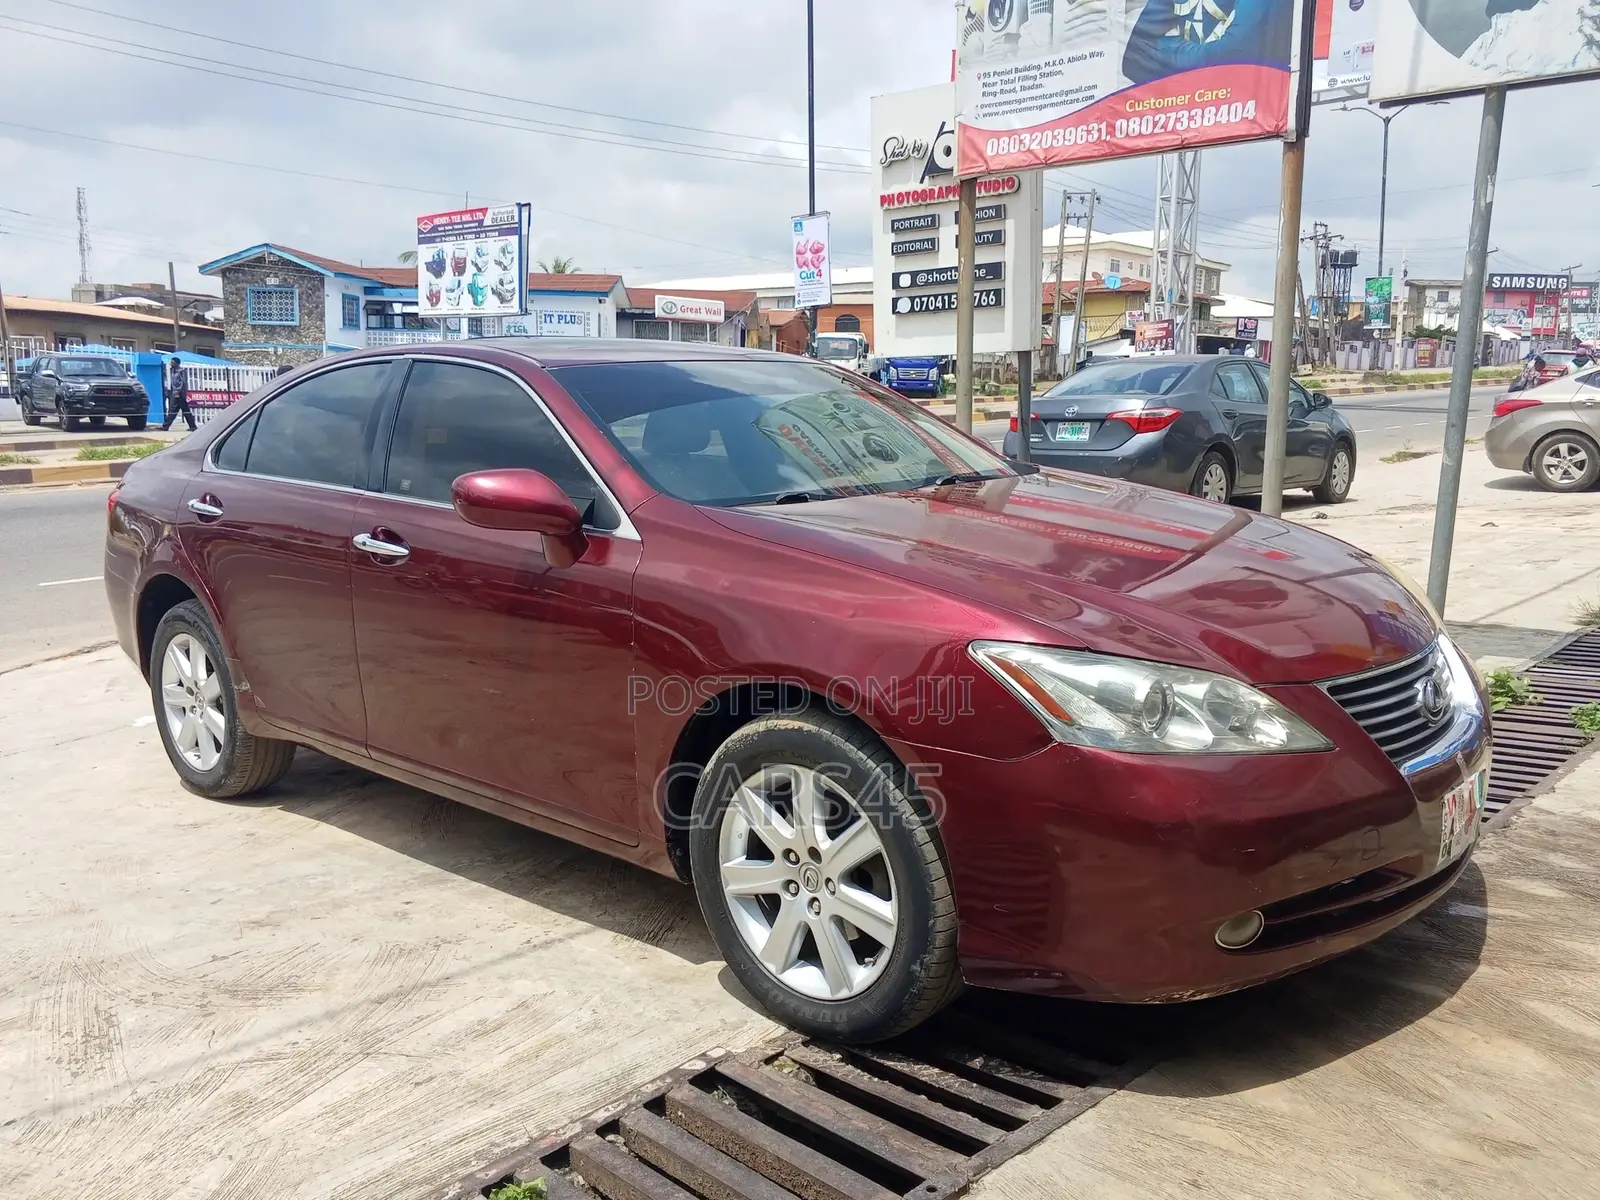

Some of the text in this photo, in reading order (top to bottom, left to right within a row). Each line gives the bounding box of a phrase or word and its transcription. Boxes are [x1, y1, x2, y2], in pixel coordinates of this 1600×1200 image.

[993, 68, 1013, 77] Peniel
[1014, 64, 1043, 73] Building,
[1044, 59, 1066, 68] M.K.O.
[1067, 53, 1087, 64] Abiola
[1089, 50, 1105, 59] Way,
[982, 69, 1064, 89] Near Total Filling Station,
[1341, 75, 1371, 84] www.lu
[980, 84, 1098, 109] overcomersgarmentcare@gmail.com
[981, 82, 1045, 98] Ring-Road, Ibadan.
[982, 94, 1095, 118] www.overcomersgarmentcare.com
[1125, 87, 1231, 113] Customer Care:
[1115, 99, 1256, 139] 08027338404
[880, 136, 908, 165] Shot
[880, 176, 1015, 207] PHOTOGRAPH TUDIO
[491, 215, 515, 224] DEALER
[894, 217, 932, 230] PORTRAIT
[893, 241, 933, 253] EDITORIAL
[800, 268, 822, 280] Cut 4
[916, 268, 994, 285] @shotbne_
[1492, 276, 1568, 290] SAMSUNG
[913, 291, 996, 312] 070415766
[543, 313, 583, 325] IT PLUS
[680, 305, 722, 317] Great Wall
